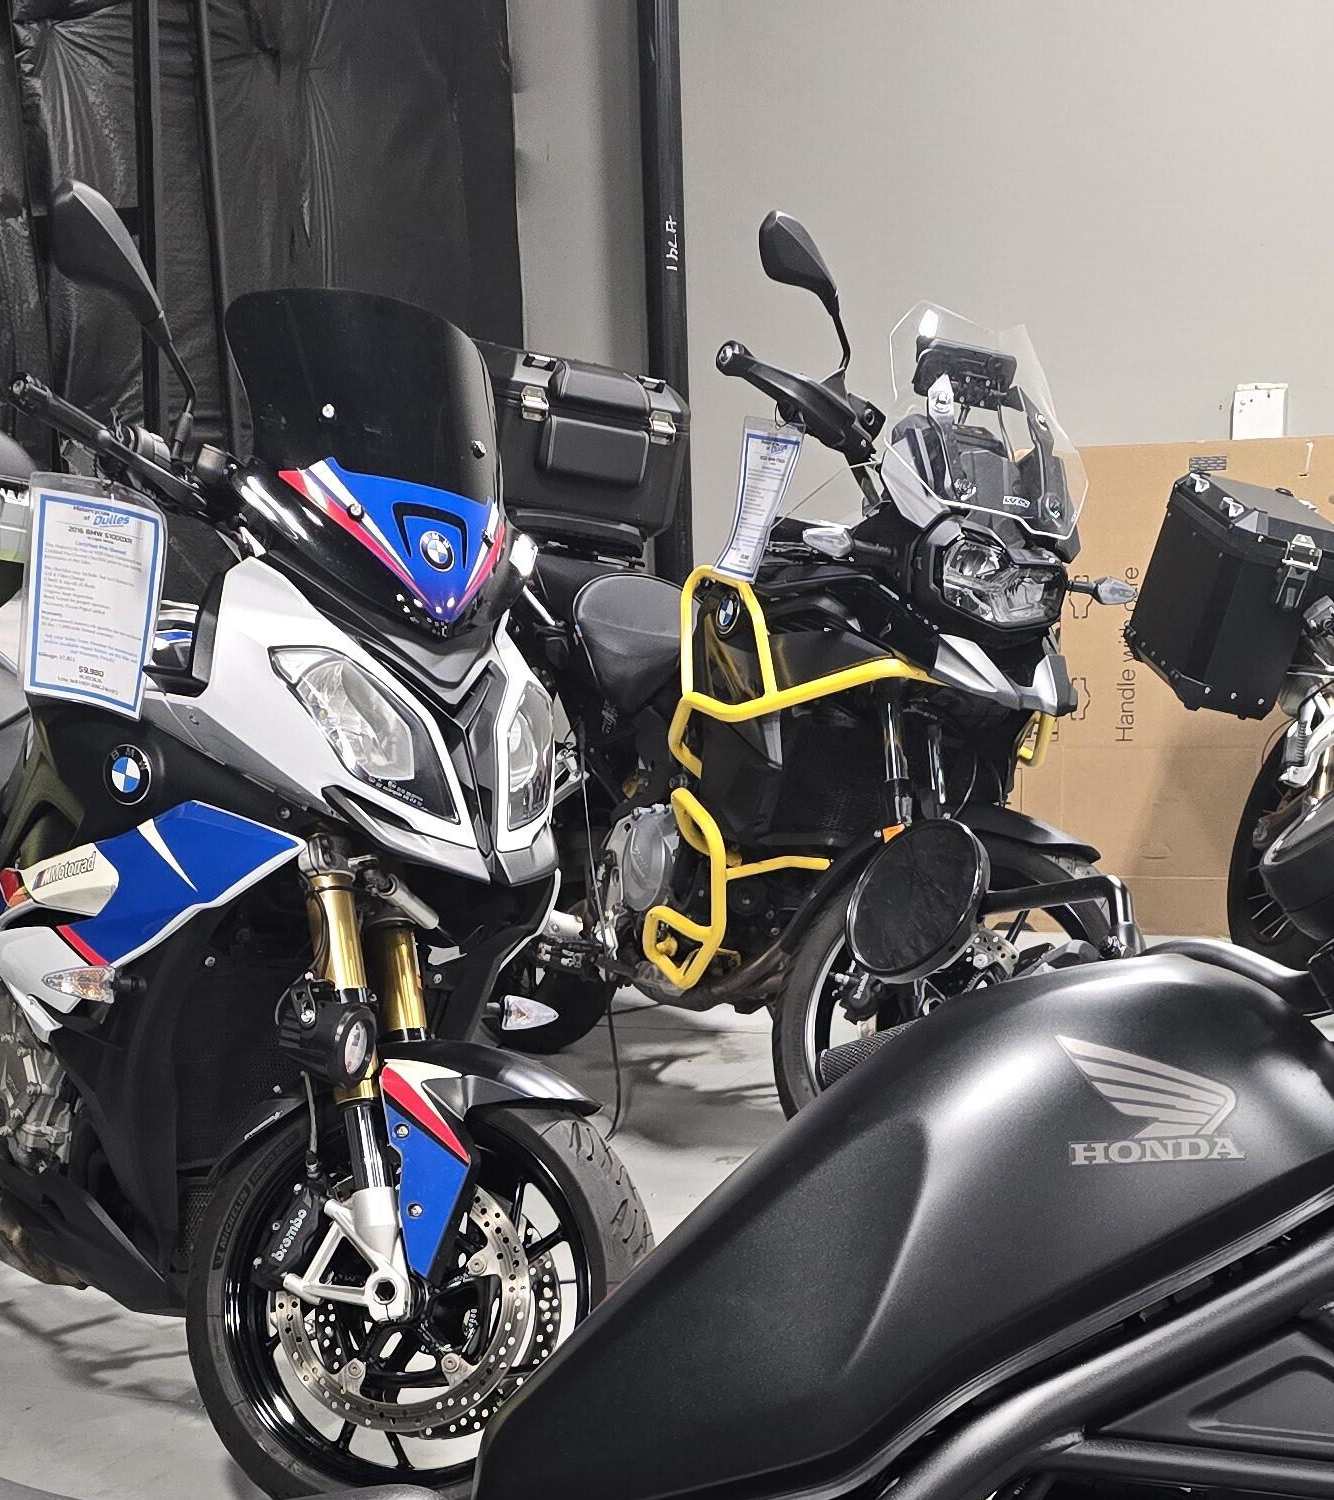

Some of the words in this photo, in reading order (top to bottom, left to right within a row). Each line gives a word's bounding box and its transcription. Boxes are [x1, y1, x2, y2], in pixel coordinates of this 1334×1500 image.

[85, 529, 103, 538] BMW
[93, 515, 130, 526] Dulles
[1115, 668, 1136, 742] Handle
[51, 850, 98, 884] Motorrad
[1070, 1137, 1246, 1166] HONDA
[220, 1190, 248, 1249] MICHELIN
[271, 1208, 307, 1262] brembo
